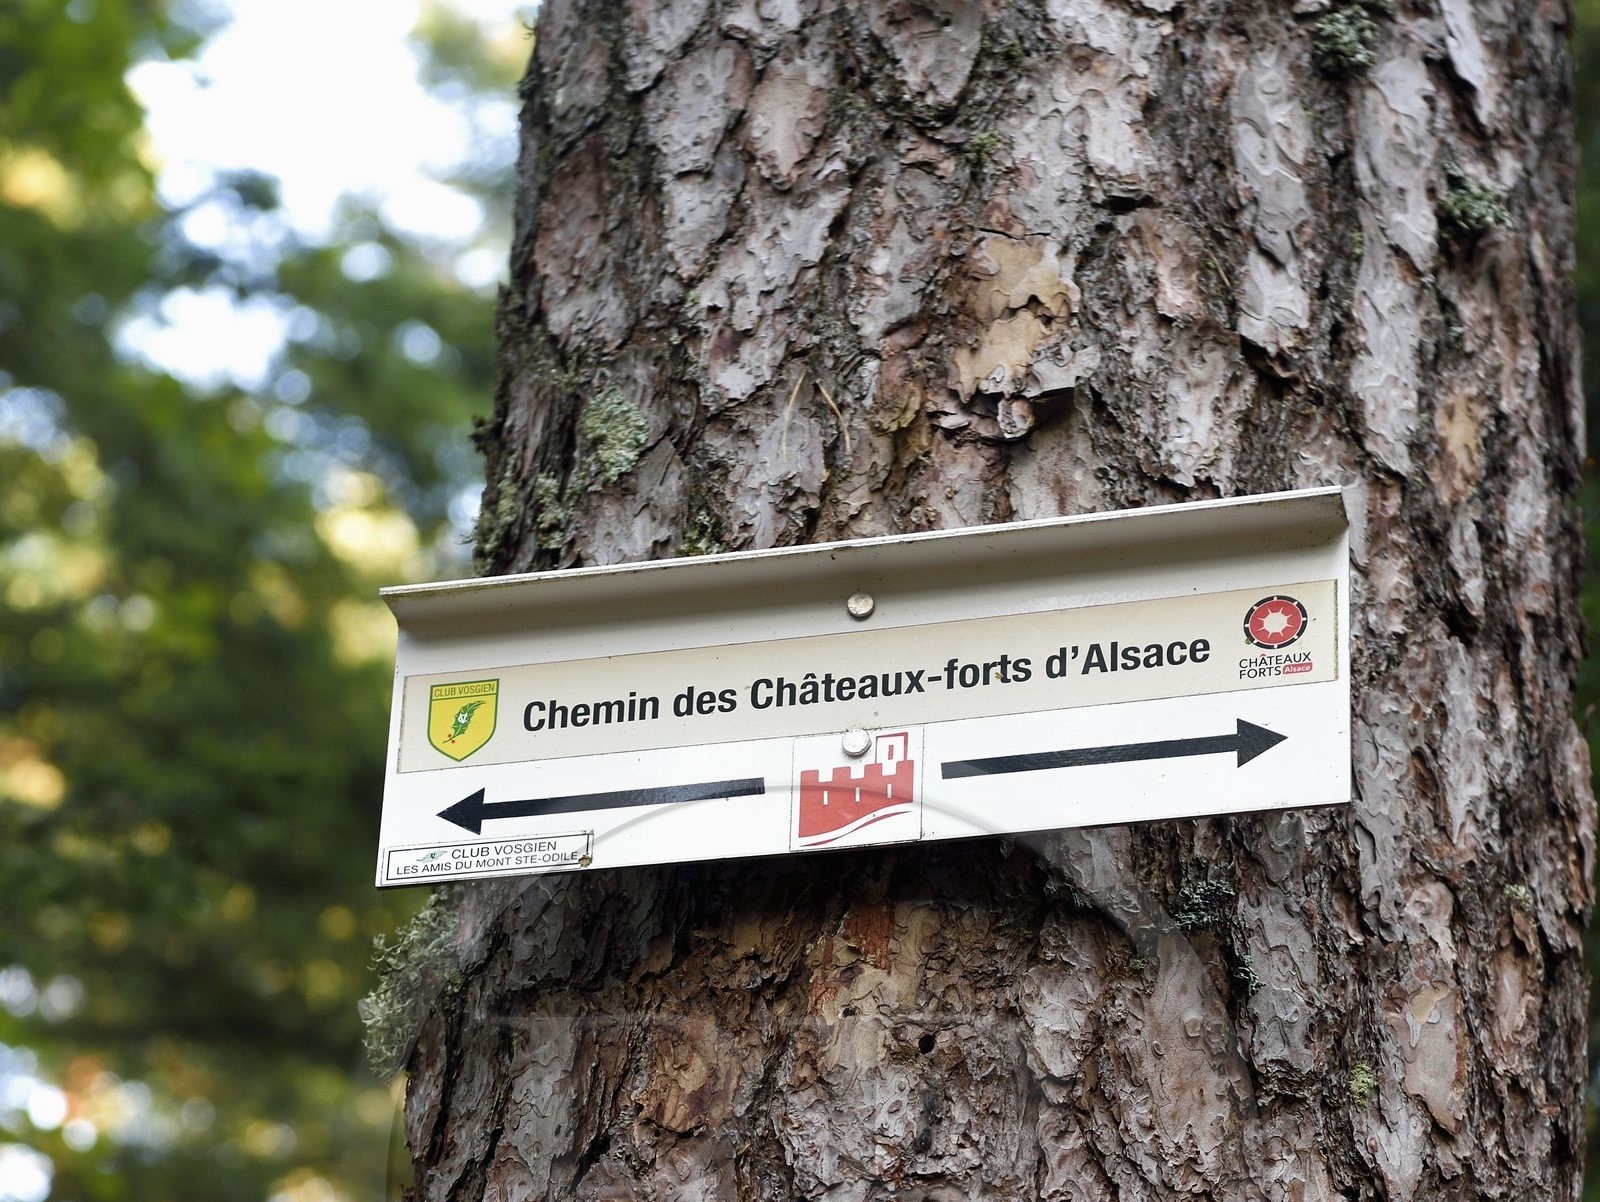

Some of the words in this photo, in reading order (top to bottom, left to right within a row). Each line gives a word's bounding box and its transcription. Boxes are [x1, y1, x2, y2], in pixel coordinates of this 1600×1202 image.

[1238, 651, 1311, 669] CHÂTEAUX
[1239, 665, 1281, 679] FORTS
[1284, 664, 1311, 673] Alsace
[434, 687, 456, 698] CLUB
[458, 683, 495, 695] VOSGIEN
[523, 691, 660, 732] Chemin
[672, 686, 737, 717] des
[750, 655, 1032, 709] Châteaux-forts
[1045, 637, 1211, 679] d’Alsace
[451, 847, 489, 860] CLUB
[494, 840, 558, 856] VOSGIEN
[396, 865, 419, 876] LES
[421, 861, 452, 874] AMIS
[455, 860, 473, 870] DU
[475, 857, 512, 869] MONT
[514, 851, 579, 865] STE-ODILE
